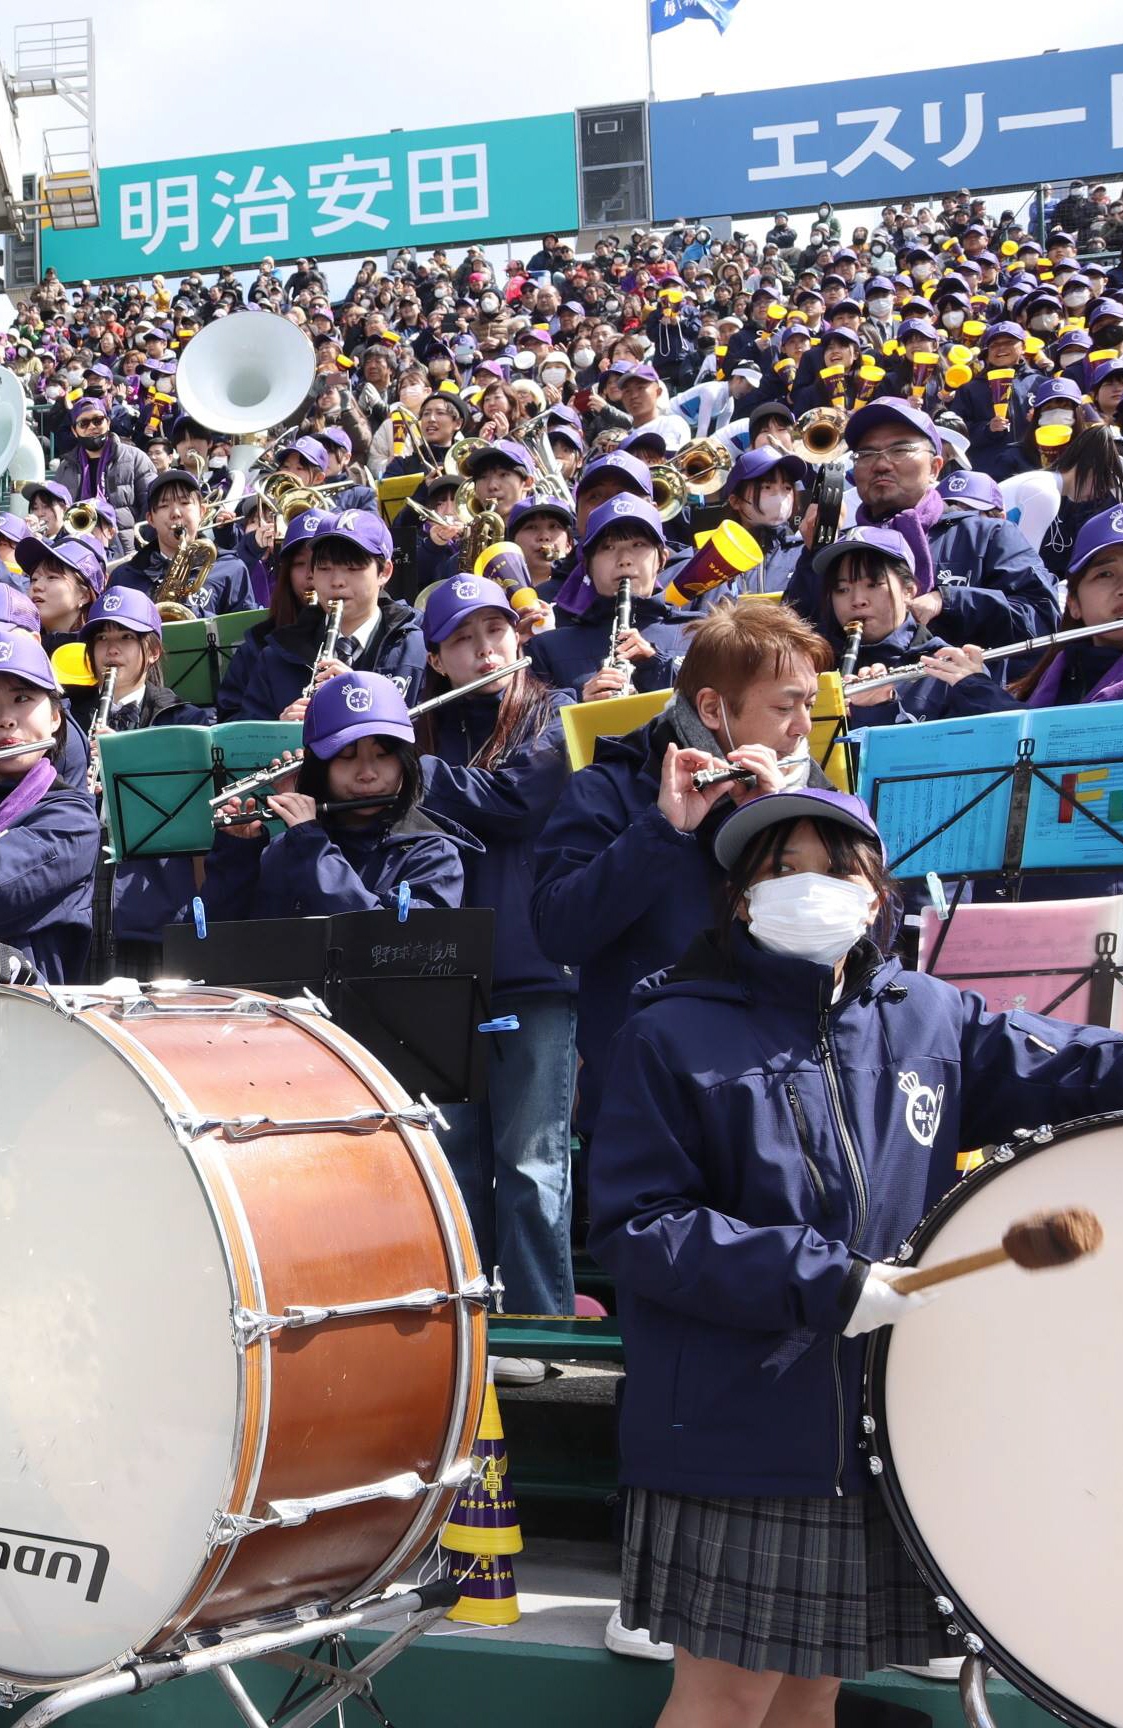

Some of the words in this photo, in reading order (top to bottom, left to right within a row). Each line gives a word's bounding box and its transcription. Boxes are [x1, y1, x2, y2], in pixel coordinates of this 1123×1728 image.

[119, 143, 490, 256] 明治安田
[335, 511, 359, 531] K
